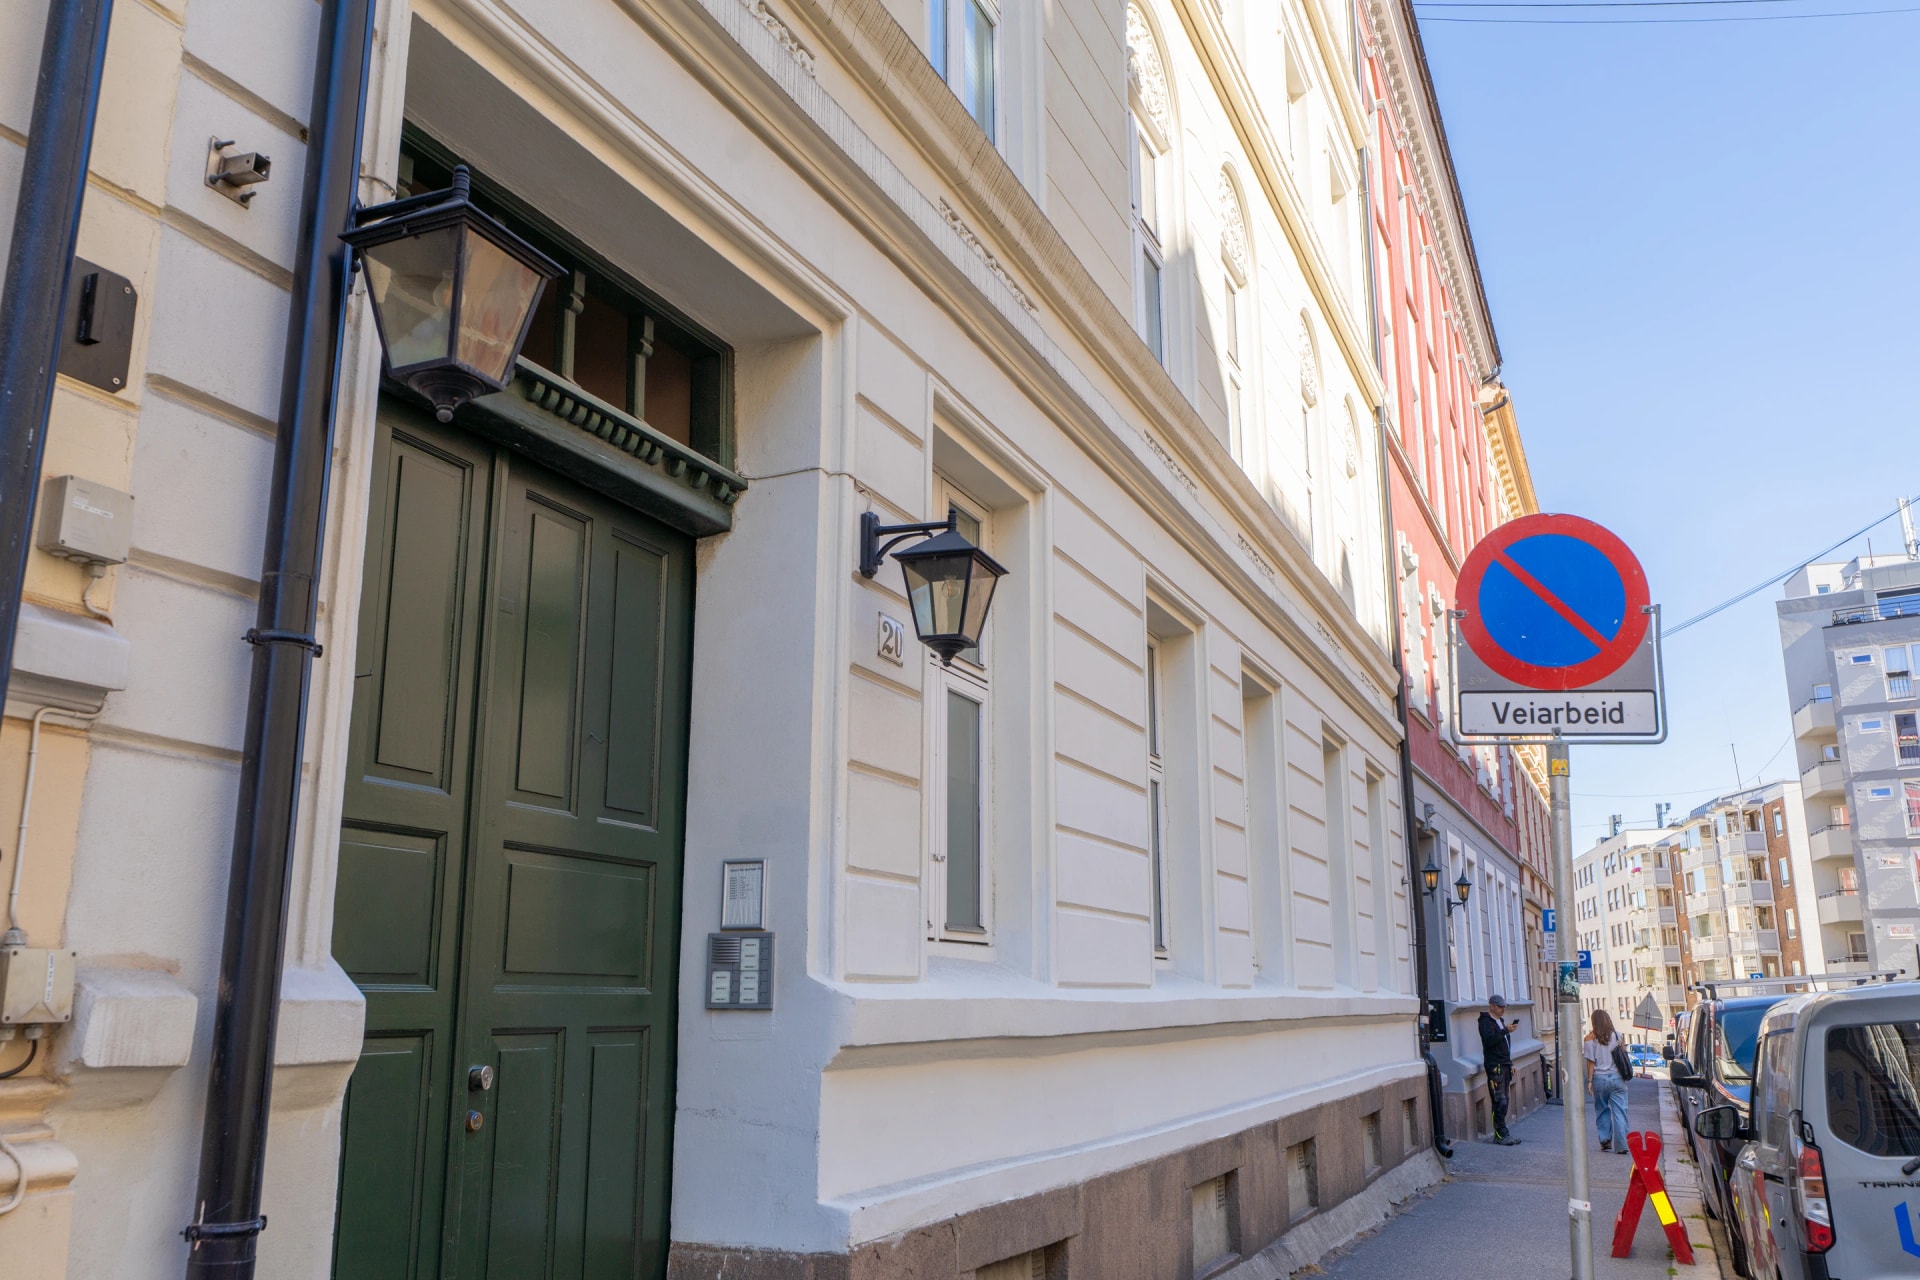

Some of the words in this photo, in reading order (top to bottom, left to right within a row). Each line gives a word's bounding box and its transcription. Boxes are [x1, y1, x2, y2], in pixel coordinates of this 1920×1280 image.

[882, 621, 902, 658] 20
[1492, 701, 1624, 725] Veiarbeid
[1577, 953, 1587, 967] P
